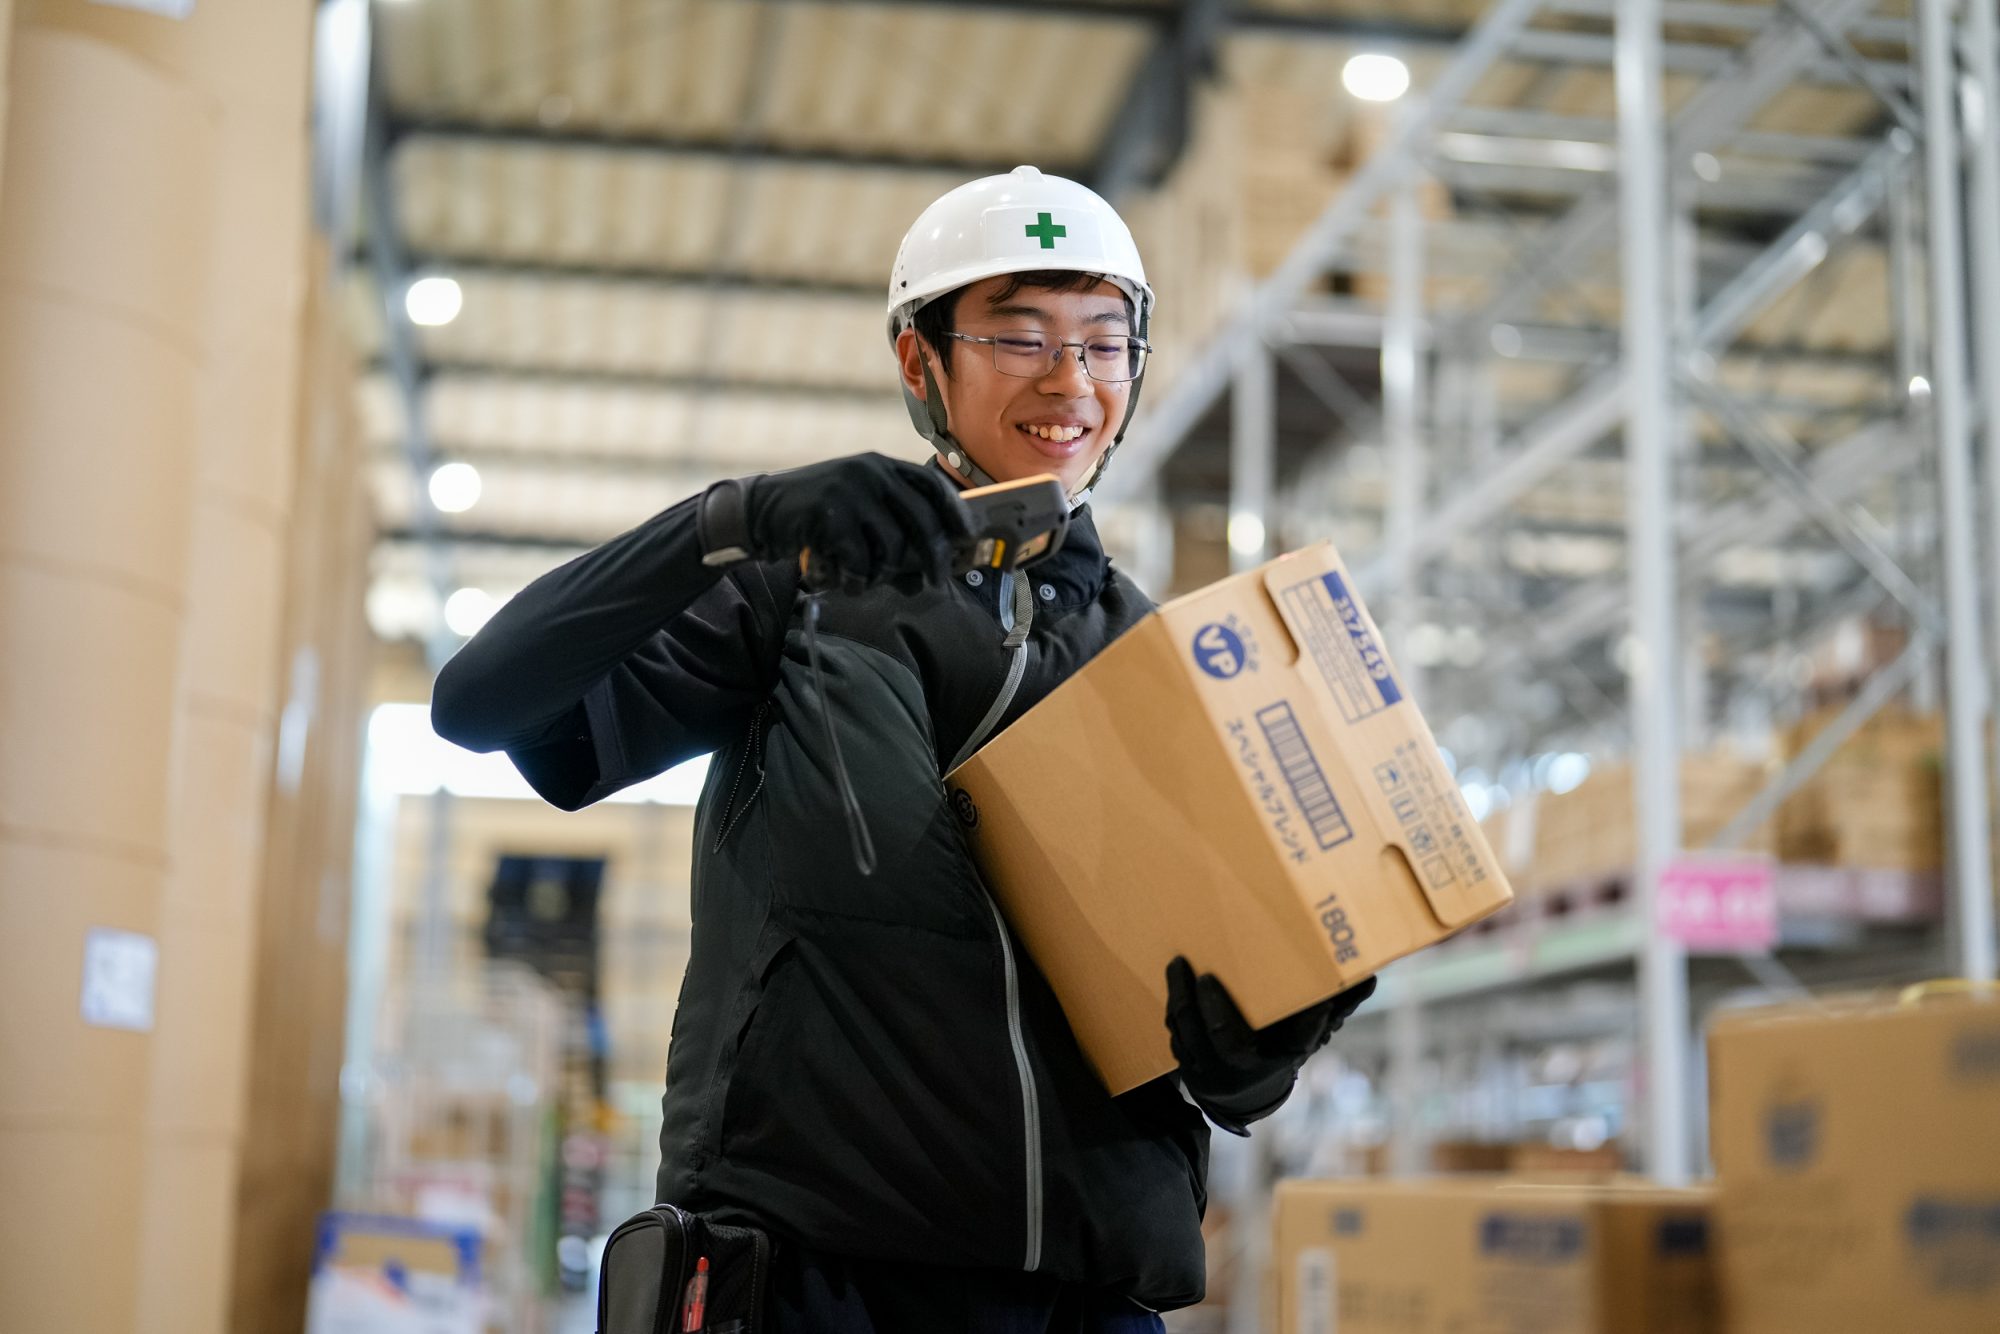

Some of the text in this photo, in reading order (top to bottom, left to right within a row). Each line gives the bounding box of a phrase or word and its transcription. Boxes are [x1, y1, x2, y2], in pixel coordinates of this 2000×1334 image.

[1197, 627, 1238, 676] VP
[1229, 721, 1308, 864] スペシャルブレンド
[1314, 893, 1360, 964] 180g
